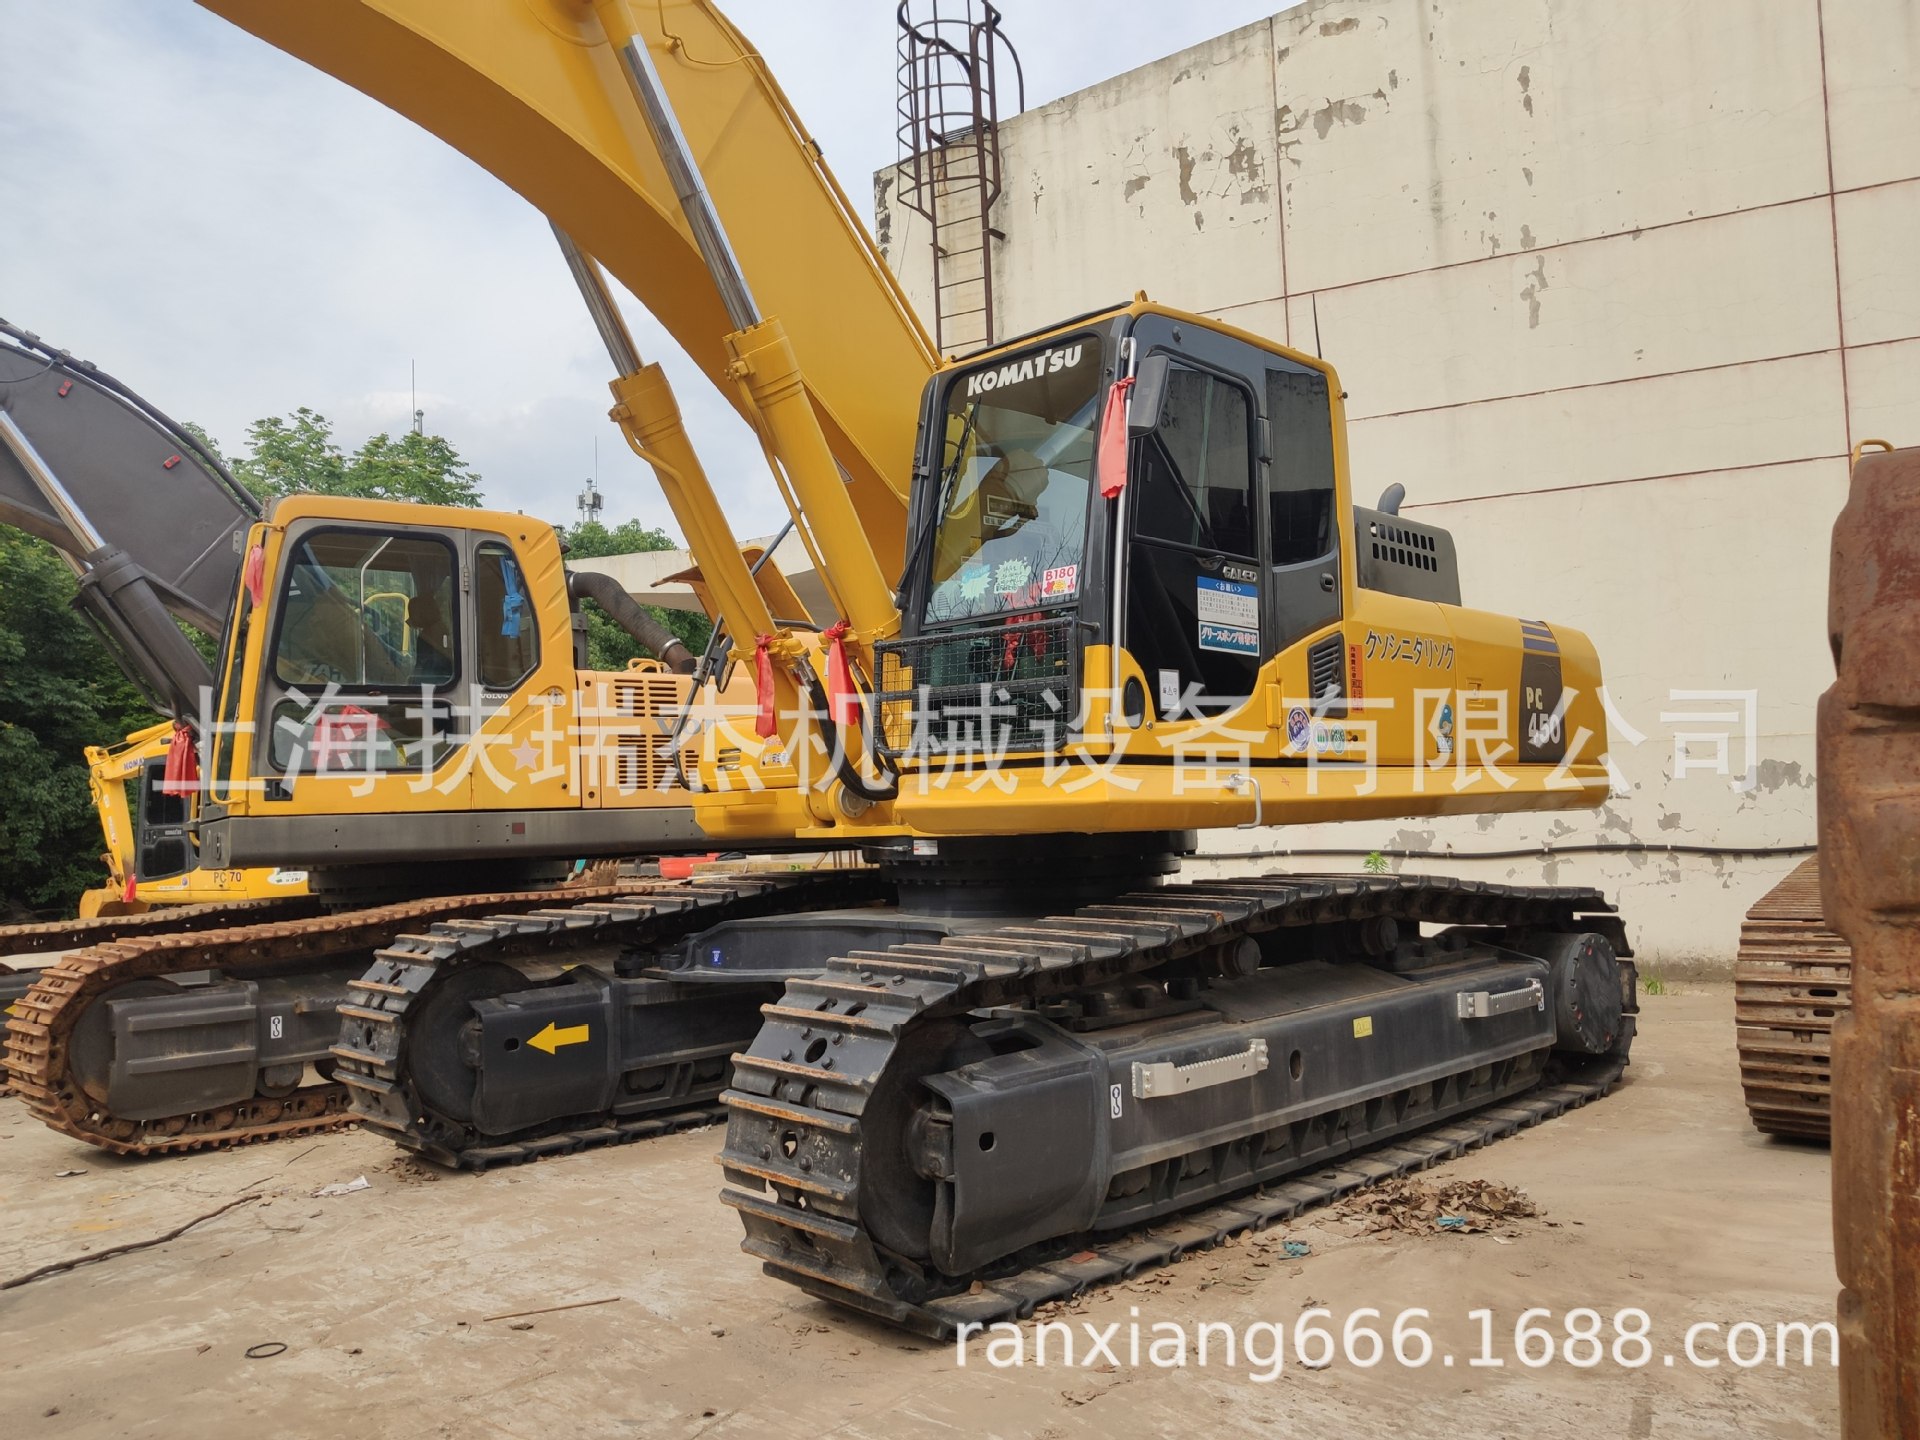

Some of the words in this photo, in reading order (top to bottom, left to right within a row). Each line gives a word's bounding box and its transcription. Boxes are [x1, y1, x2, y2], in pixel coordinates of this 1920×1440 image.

[967, 345, 1082, 397] KOMATSU
[1045, 567, 1074, 581] B180
[1526, 686, 1543, 710] PC
[1528, 713, 1561, 744] 450
[213, 871, 227, 884] PC
[229, 871, 242, 883] 70
